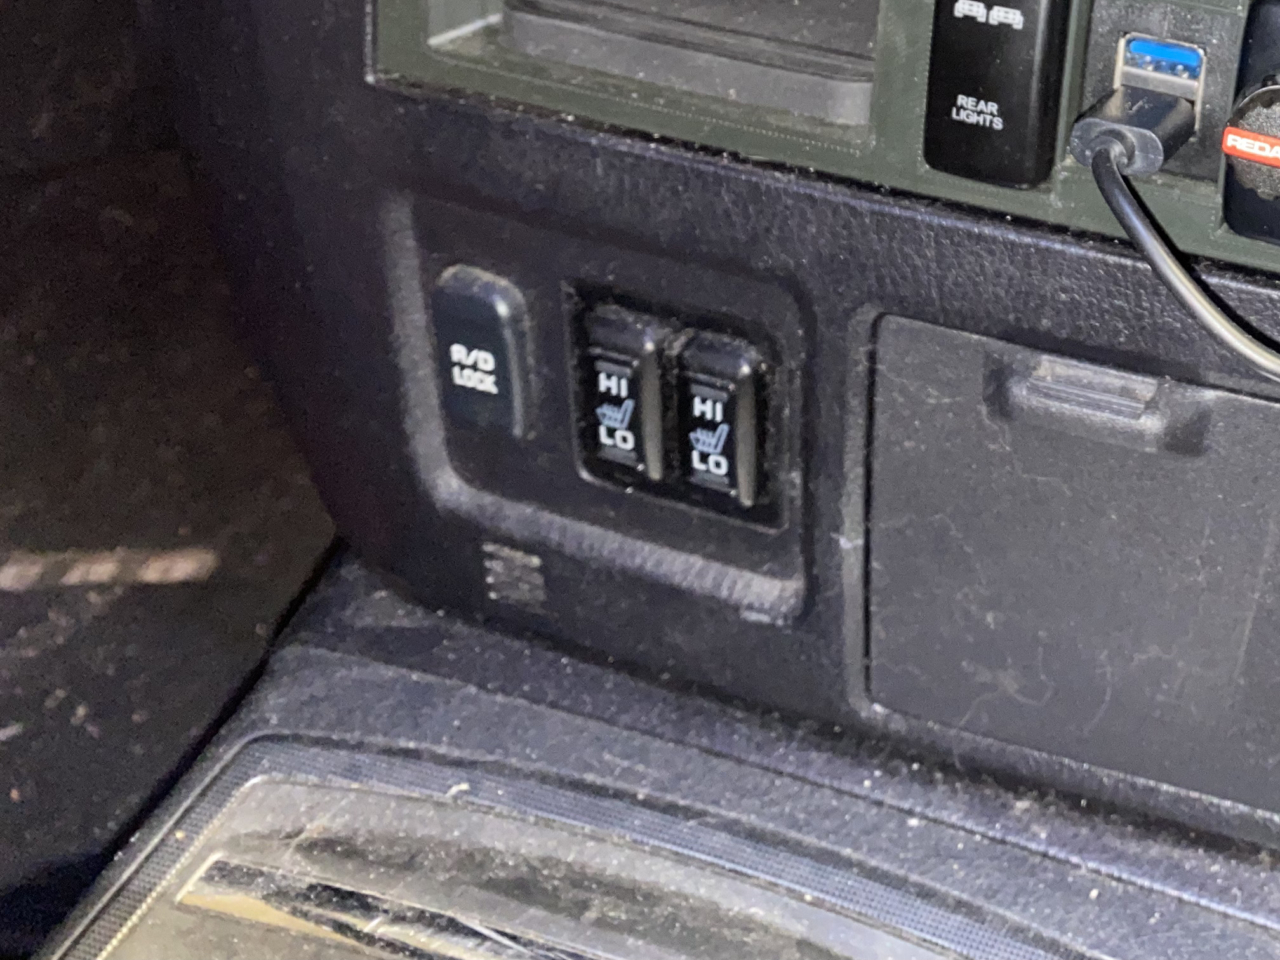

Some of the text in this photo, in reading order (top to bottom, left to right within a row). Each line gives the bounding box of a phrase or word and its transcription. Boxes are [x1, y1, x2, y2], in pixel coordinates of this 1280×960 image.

[956, 94, 999, 115] REAR
[951, 106, 1004, 131] LIGHTS
[452, 365, 499, 395] LOCK
[598, 372, 629, 399] HI
[692, 395, 724, 423] HI
[598, 424, 636, 451] LO
[691, 449, 729, 476] LO
